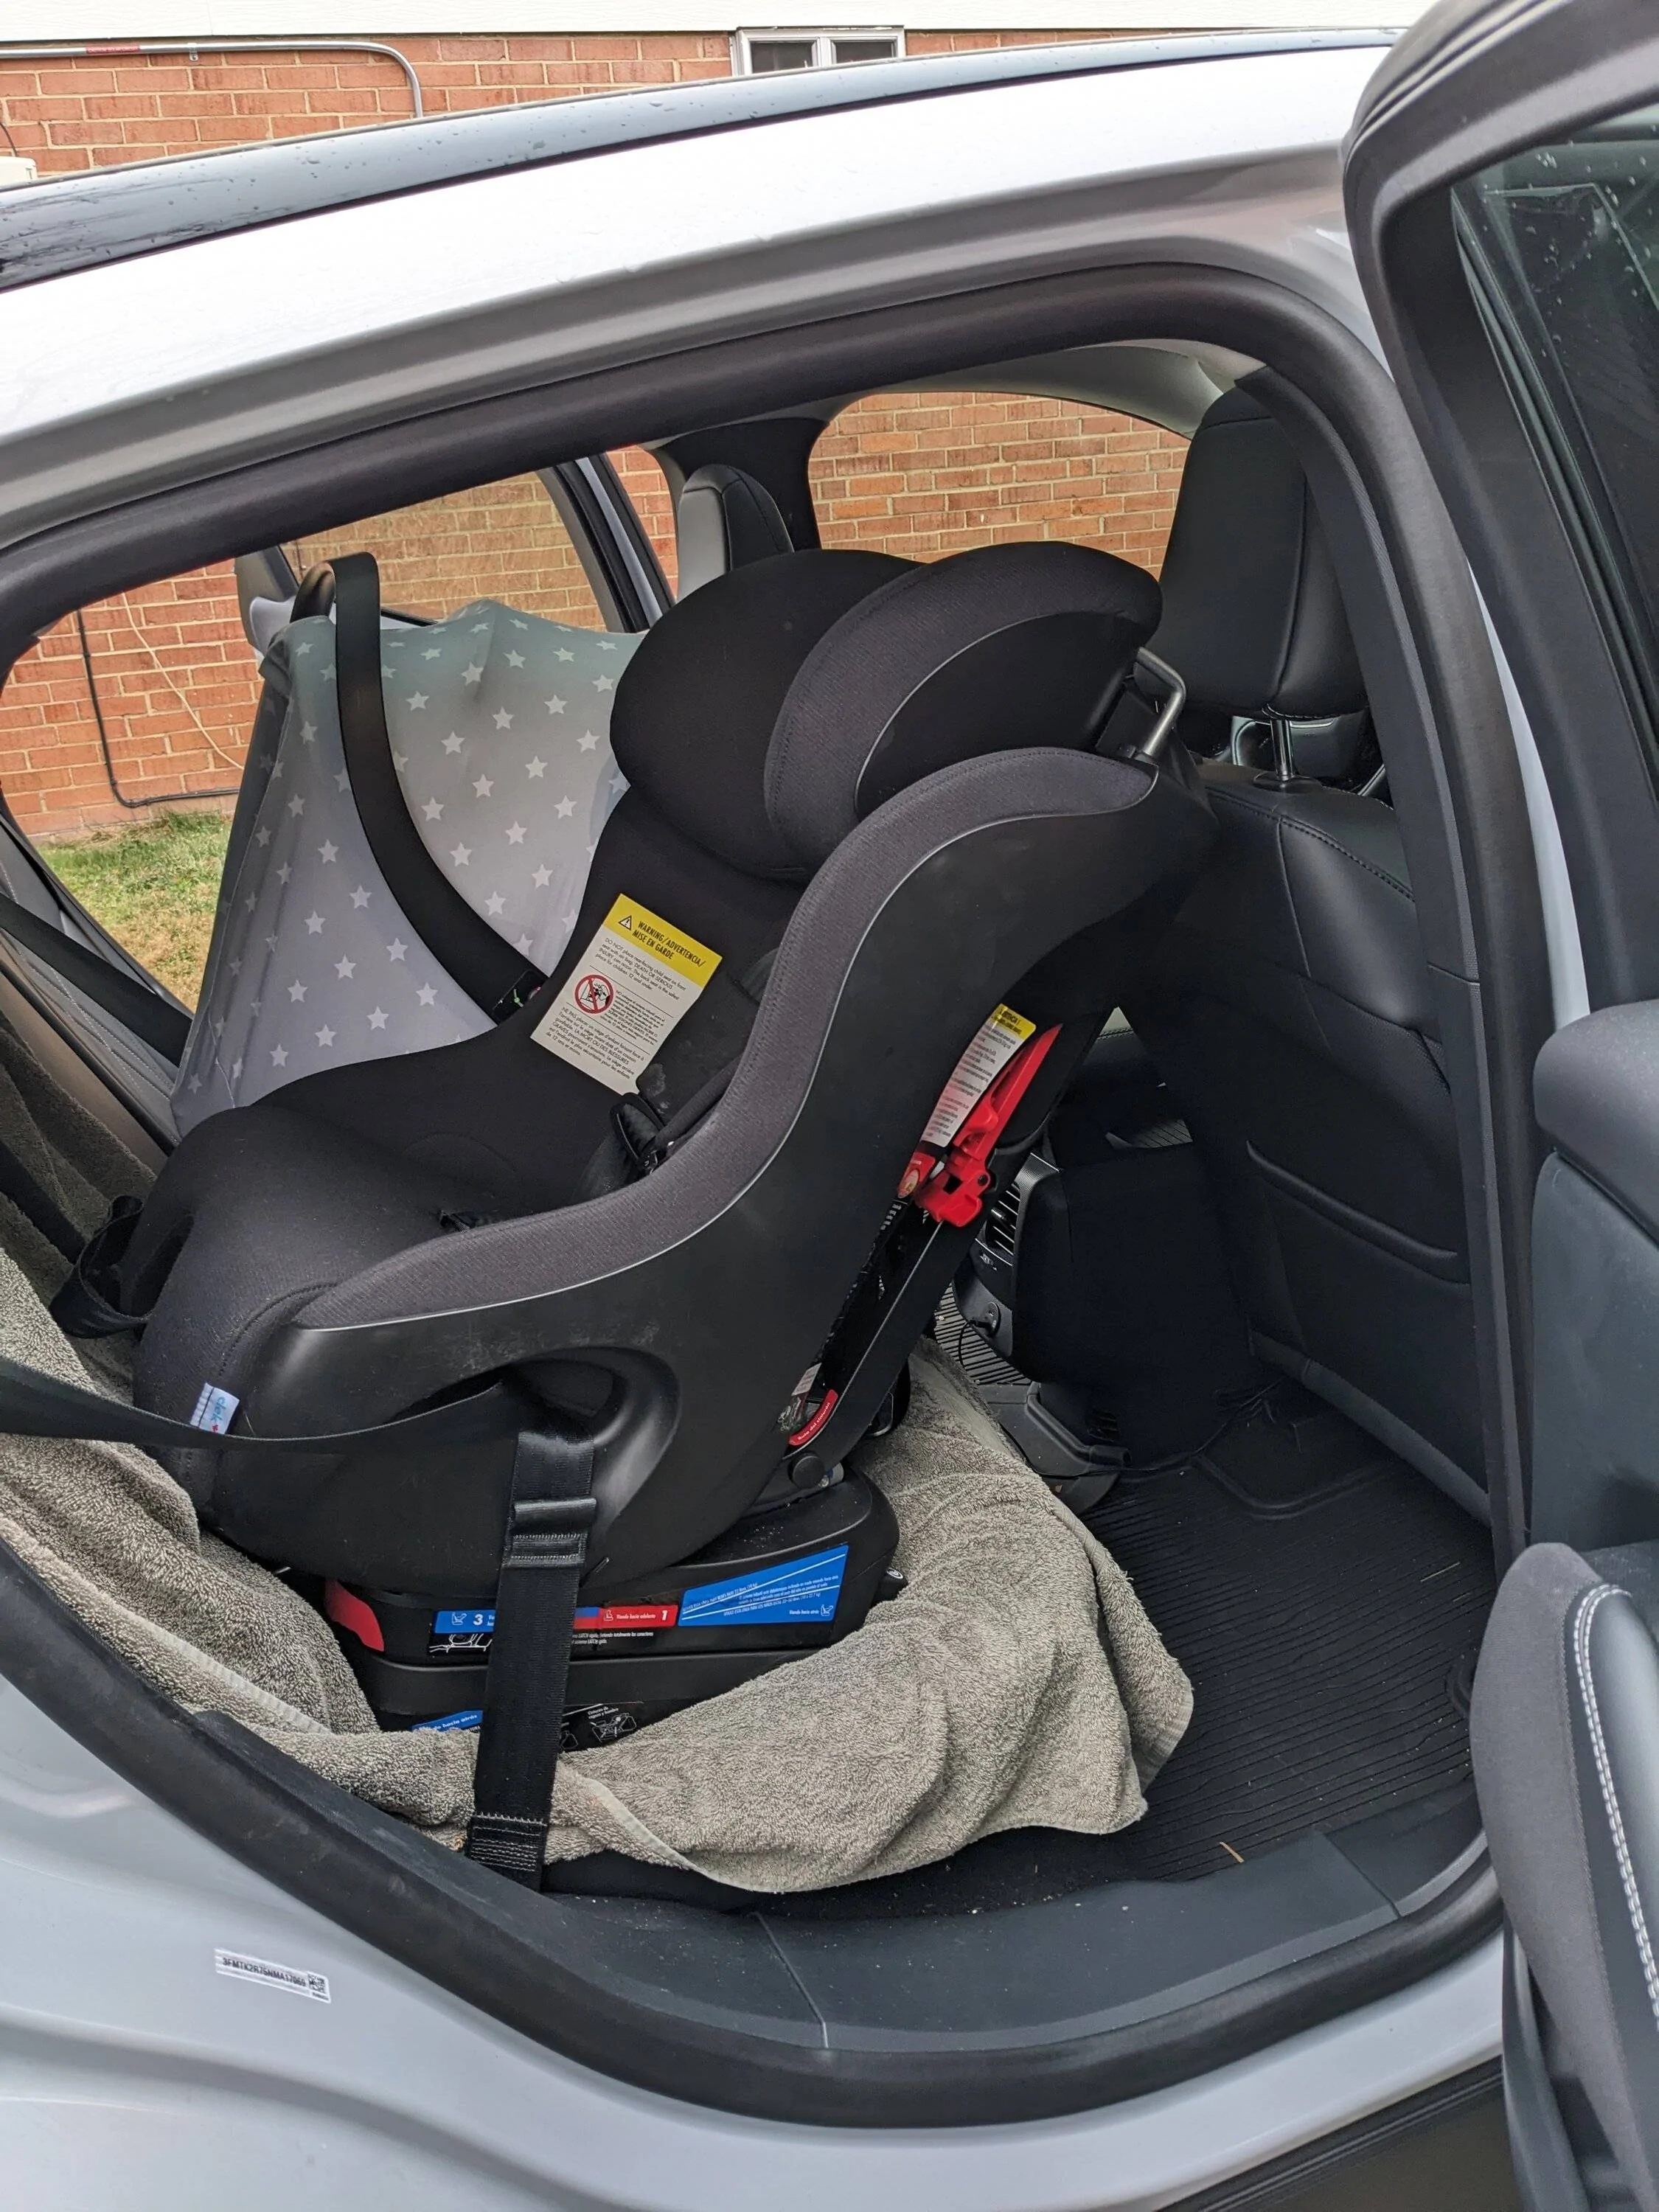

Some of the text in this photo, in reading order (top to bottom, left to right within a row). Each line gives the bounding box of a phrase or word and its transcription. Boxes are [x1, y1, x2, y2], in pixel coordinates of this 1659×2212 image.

[631, 928, 675, 959] MISE EN GARDE
[594, 952, 608, 962] place
[598, 947, 613, 959] INJURY
[604, 936, 613, 945] DO
[612, 942, 624, 951] NOT
[622, 948, 634, 959] place
[653, 967, 664, 977] child
[676, 982, 686, 991] front
[633, 962, 649, 974] DEATH
[647, 970, 655, 978] OR
[654, 975, 673, 990] SERIOUS
[567, 1010, 577, 1019] PAS
[579, 1032, 593, 1043] MORT
[591, 1039, 600, 1047] OU
[599, 1043, 609, 1052] DES
[607, 1048, 630, 1065] BLESSURES
[211, 1397, 226, 1423] clek
[473, 1613, 484, 1626] 3
[661, 1610, 668, 1621] 1
[441, 1718, 460, 1728] hacia
